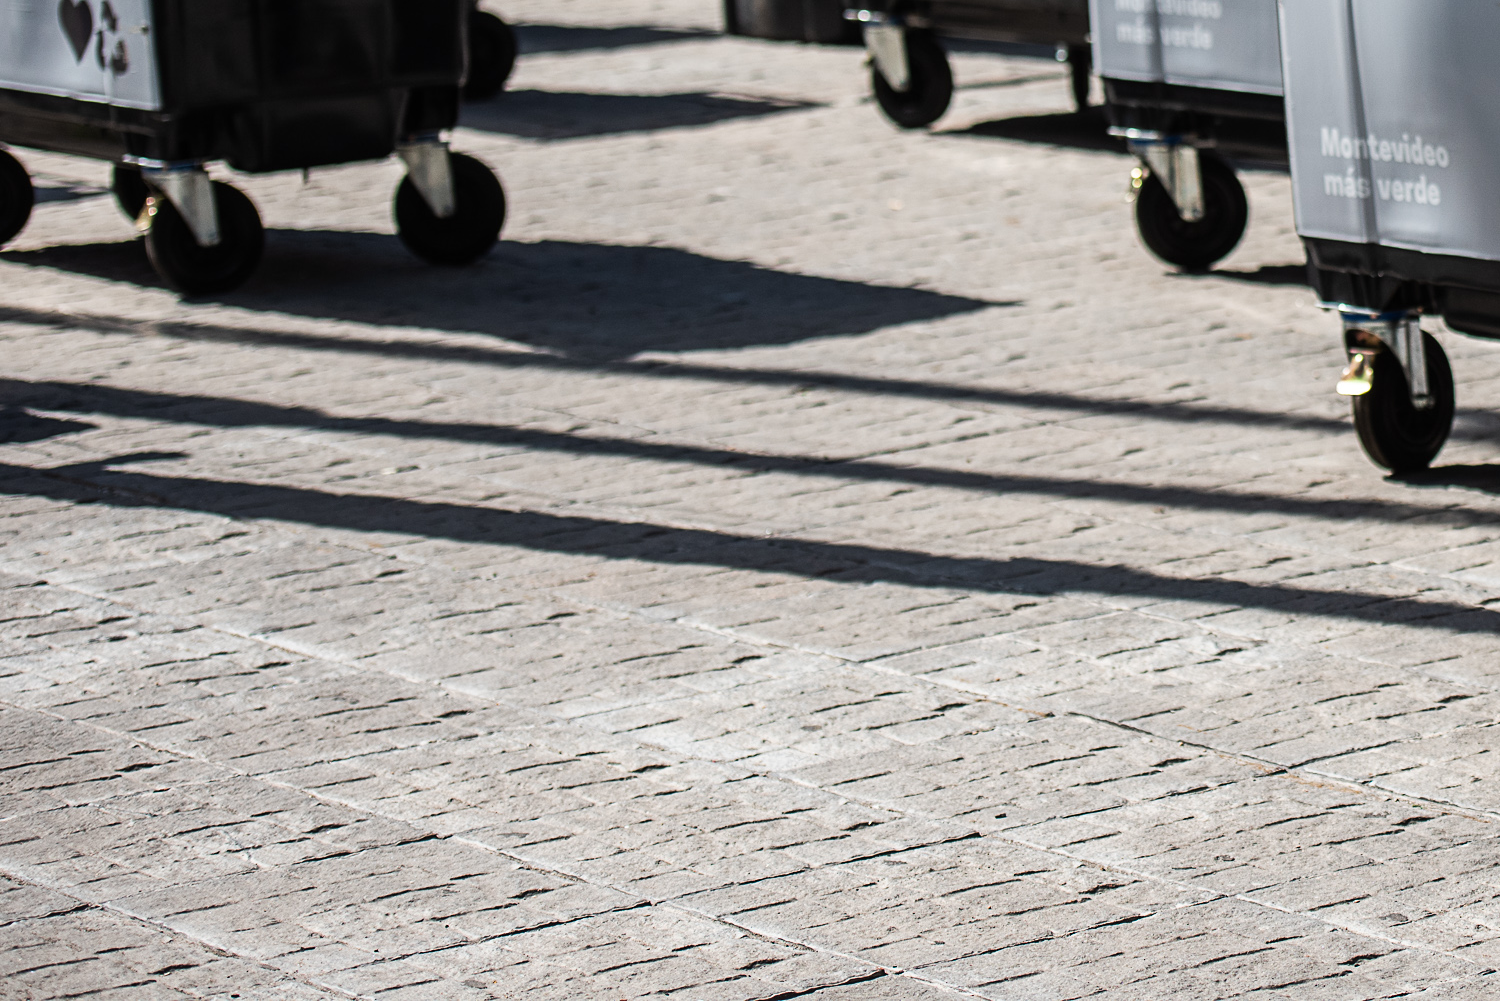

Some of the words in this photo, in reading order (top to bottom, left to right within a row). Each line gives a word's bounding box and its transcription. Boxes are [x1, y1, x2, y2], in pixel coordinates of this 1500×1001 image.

[1321, 127, 1449, 168] Montevideo
[1324, 167, 1370, 199] más
[1378, 174, 1441, 206] verde
